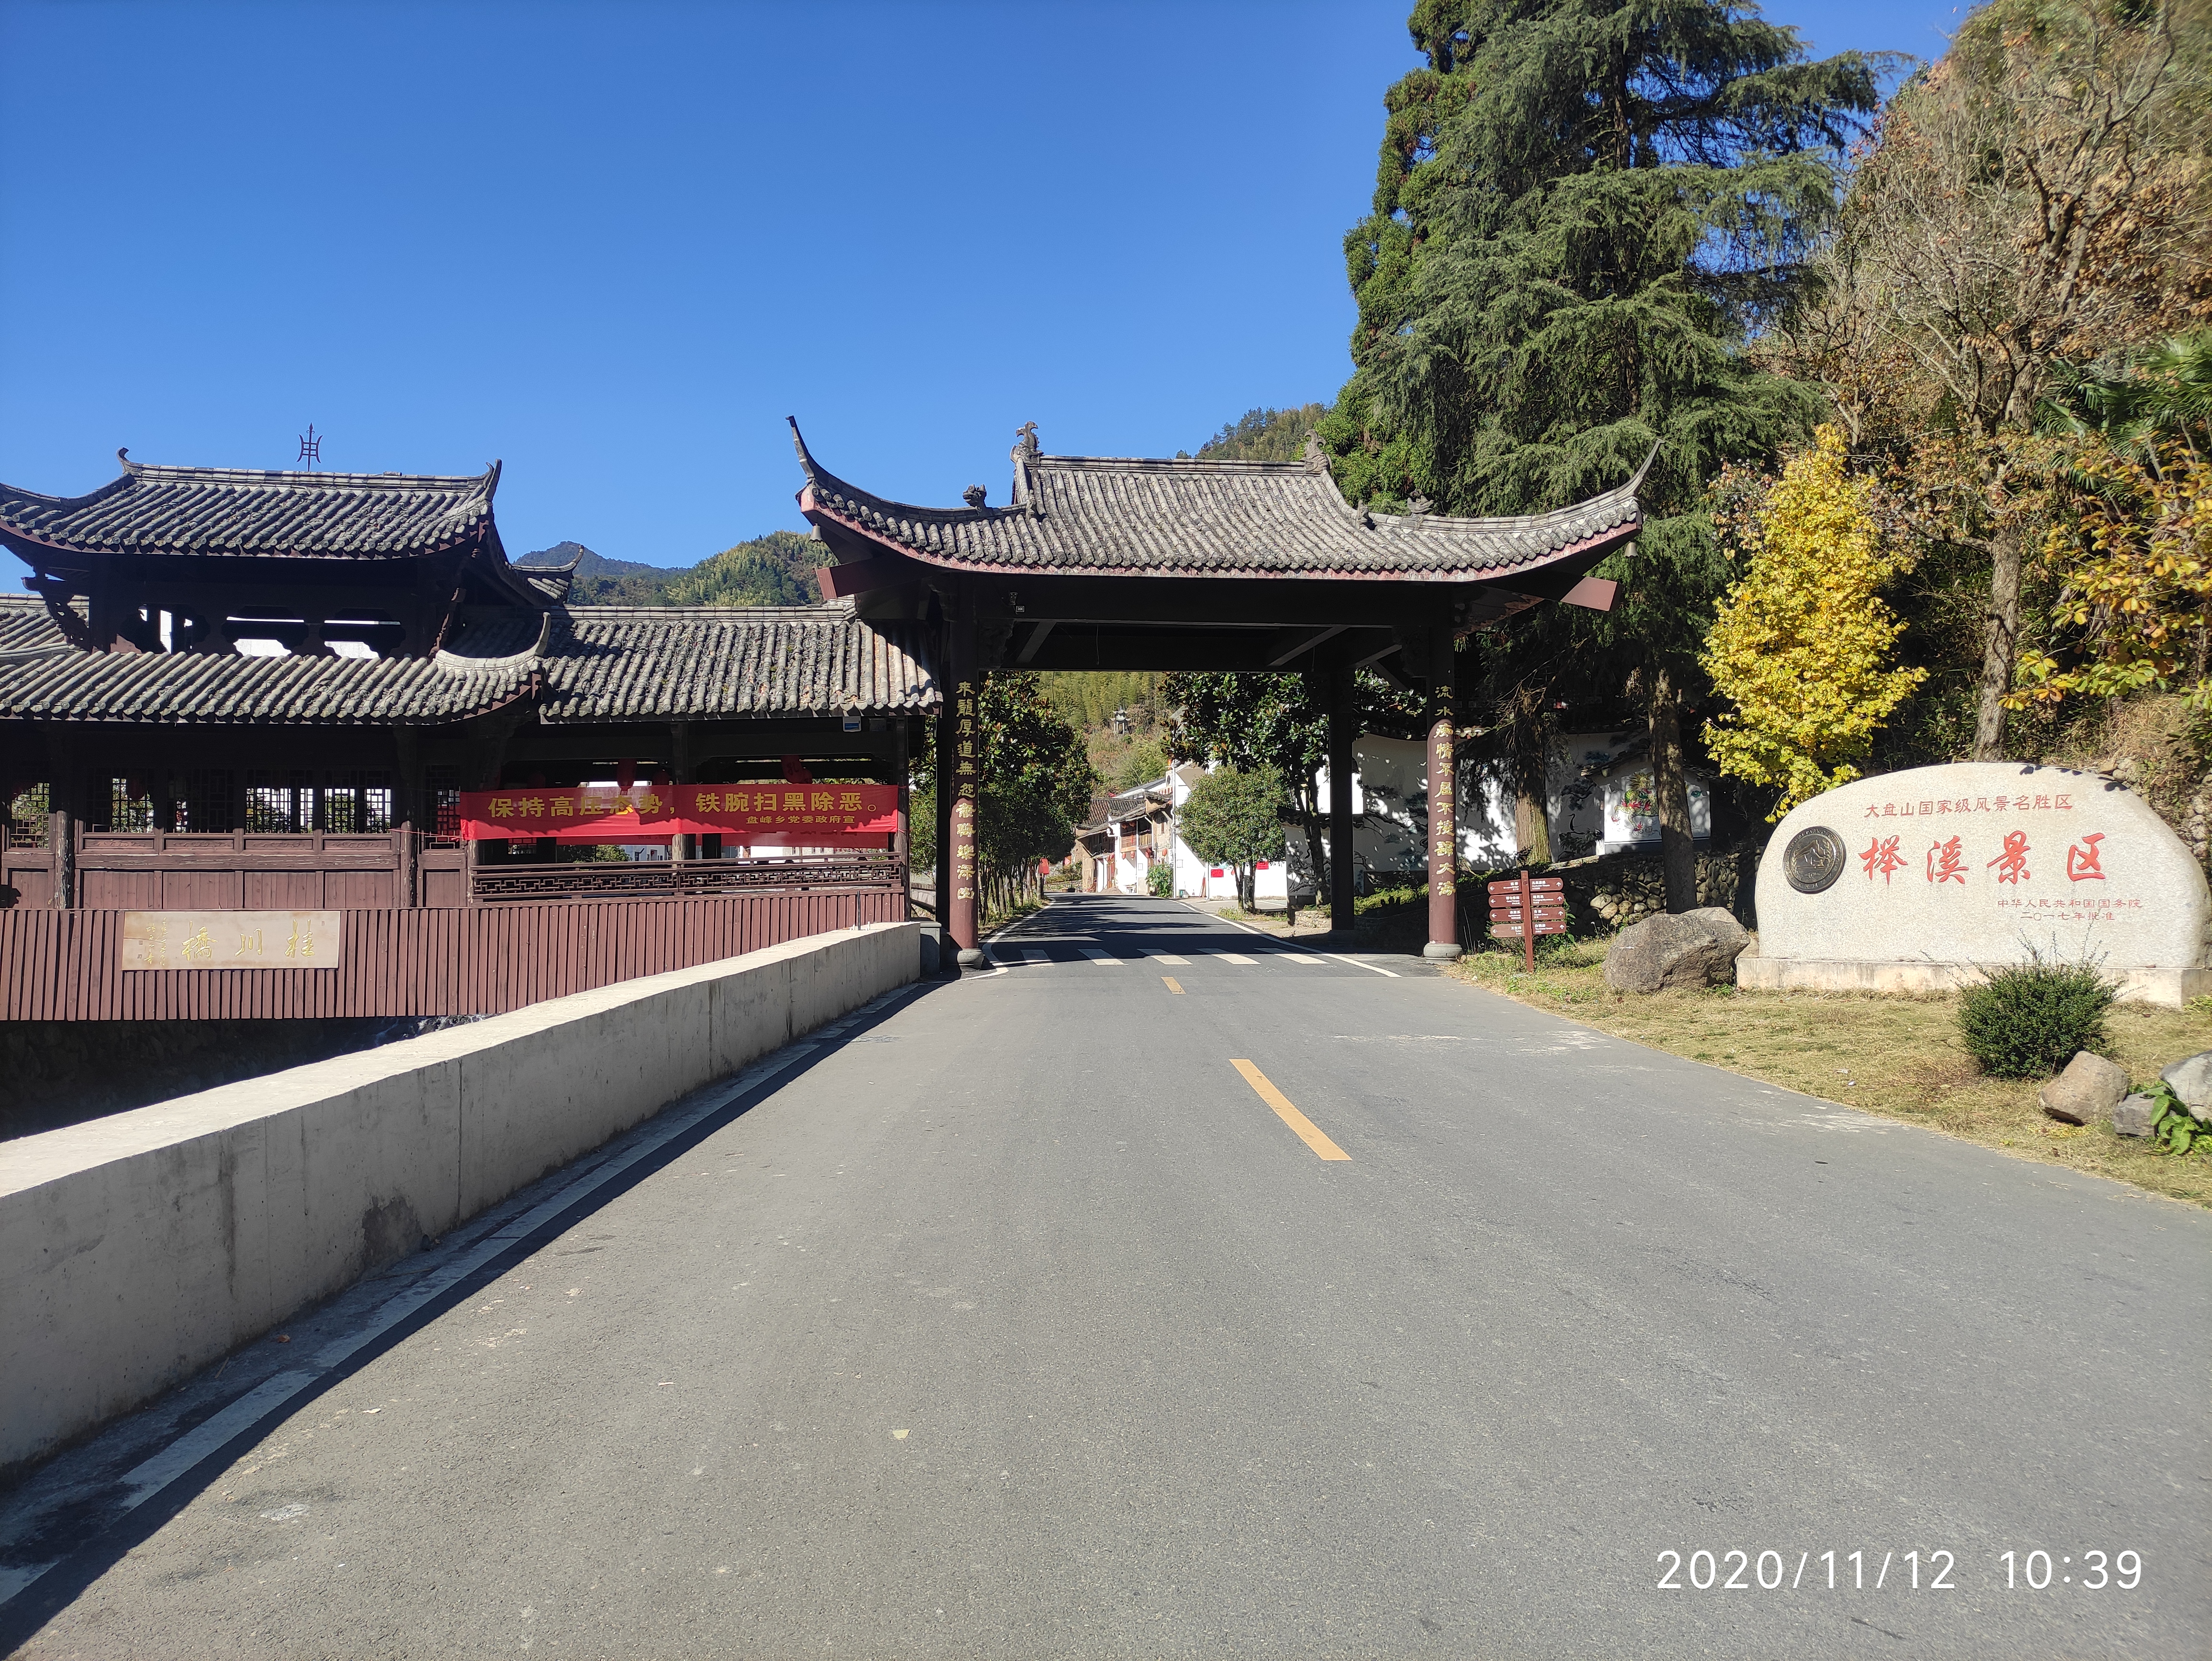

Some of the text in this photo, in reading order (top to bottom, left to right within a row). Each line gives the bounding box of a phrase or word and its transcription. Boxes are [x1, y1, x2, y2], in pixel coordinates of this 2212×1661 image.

[1864, 794, 2073, 818] 大盘山国家级风景名胜区
[745, 815, 855, 824] 盘峰乡党委政府宣
[1859, 830, 2106, 886] 榉溪景区
[1998, 899, 2142, 908] 中华人民共和国国务院
